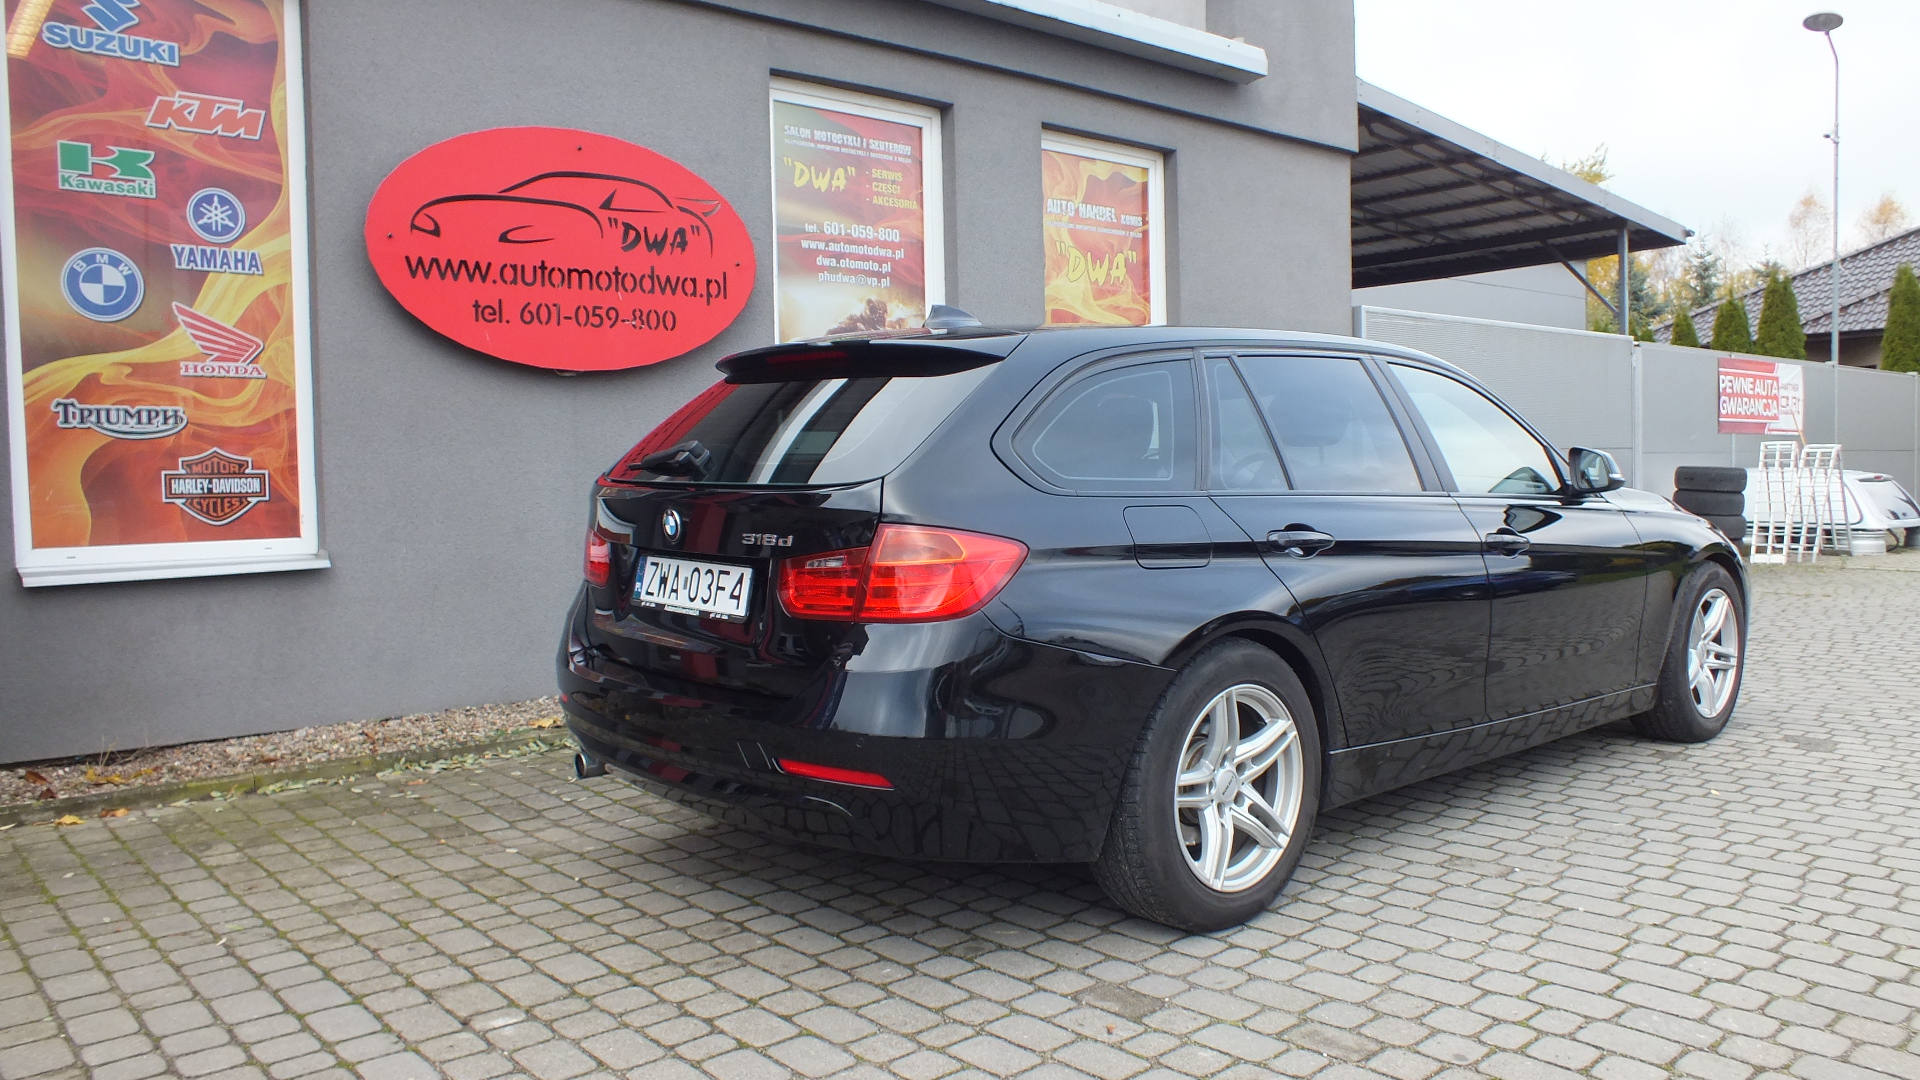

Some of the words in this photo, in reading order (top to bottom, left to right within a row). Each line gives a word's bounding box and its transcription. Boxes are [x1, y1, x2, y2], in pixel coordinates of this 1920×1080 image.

[42, 22, 180, 66] SUZUKI
[146, 91, 265, 140] KTM
[783, 125, 811, 139] SALON
[813, 129, 862, 149] MOTOCYKLI
[868, 138, 912, 155] SKUTERÓW
[59, 173, 156, 198] Kawasaki
[871, 168, 903, 182] SERWIS
[871, 181, 901, 195] CZĘŚCI
[872, 195, 918, 210] AKCESORIA
[1046, 198, 1075, 218] AUTO
[1078, 203, 1118, 223] HANDEL
[607, 217, 701, 256] "DWA"
[804, 222, 820, 233] tel.
[823, 220, 901, 243] 601-059-800
[171, 244, 263, 274] YAMAHA
[801, 239, 905, 261] www.automotodwa.pl
[73, 253, 132, 277] BMW
[816, 255, 891, 274] dwa.otomoto.pl
[405, 255, 728, 306] www.automotodwa.pl
[818, 271, 891, 289] phudwa@vp.pl
[472, 299, 510, 325] tel.
[519, 302, 677, 332] 601-059-800
[181, 362, 265, 377] HONDA
[1720, 375, 1754, 395] PEWNE
[1754, 378, 1779, 397] AUTA
[53, 400, 186, 430] TRIUMPH
[1720, 395, 1779, 418] GWARANCJA
[191, 454, 239, 474] MOTOR
[171, 477, 261, 494] HARLEY-DAVIDSON
[192, 499, 241, 516] CYCLES
[741, 532, 795, 547] 318d
[645, 561, 680, 601] ZWA
[688, 566, 745, 611] 03F4
